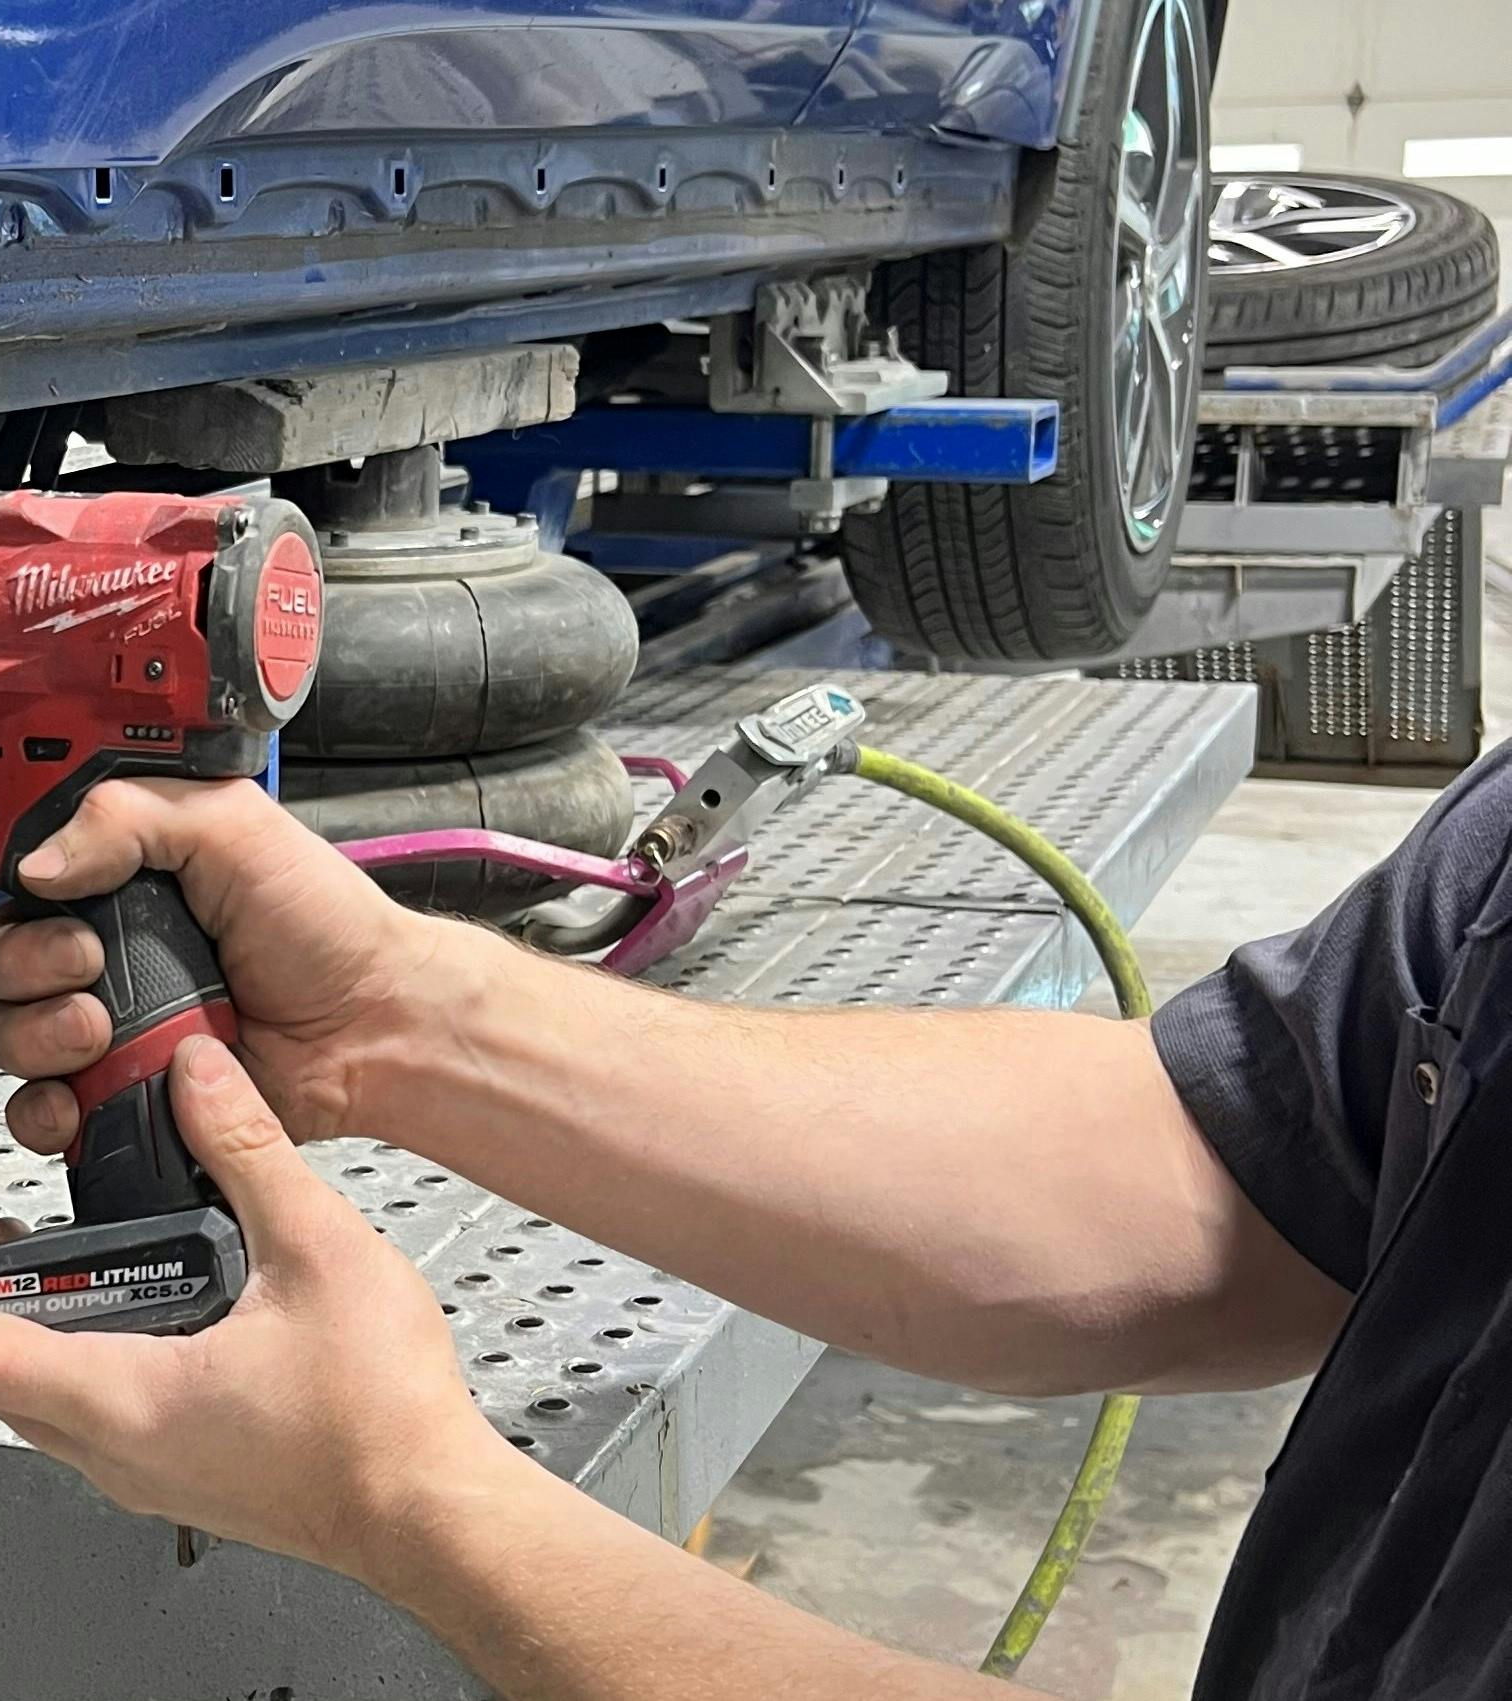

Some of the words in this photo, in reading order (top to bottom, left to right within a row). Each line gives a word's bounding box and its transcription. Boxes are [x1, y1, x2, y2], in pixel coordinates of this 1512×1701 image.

[6, 560, 178, 616] Milwaukee
[264, 584, 317, 617] FUEL
[123, 603, 183, 645] FUEL
[45, 1289, 126, 1312] OUTPUT
[129, 1282, 193, 1302] XC5.0
